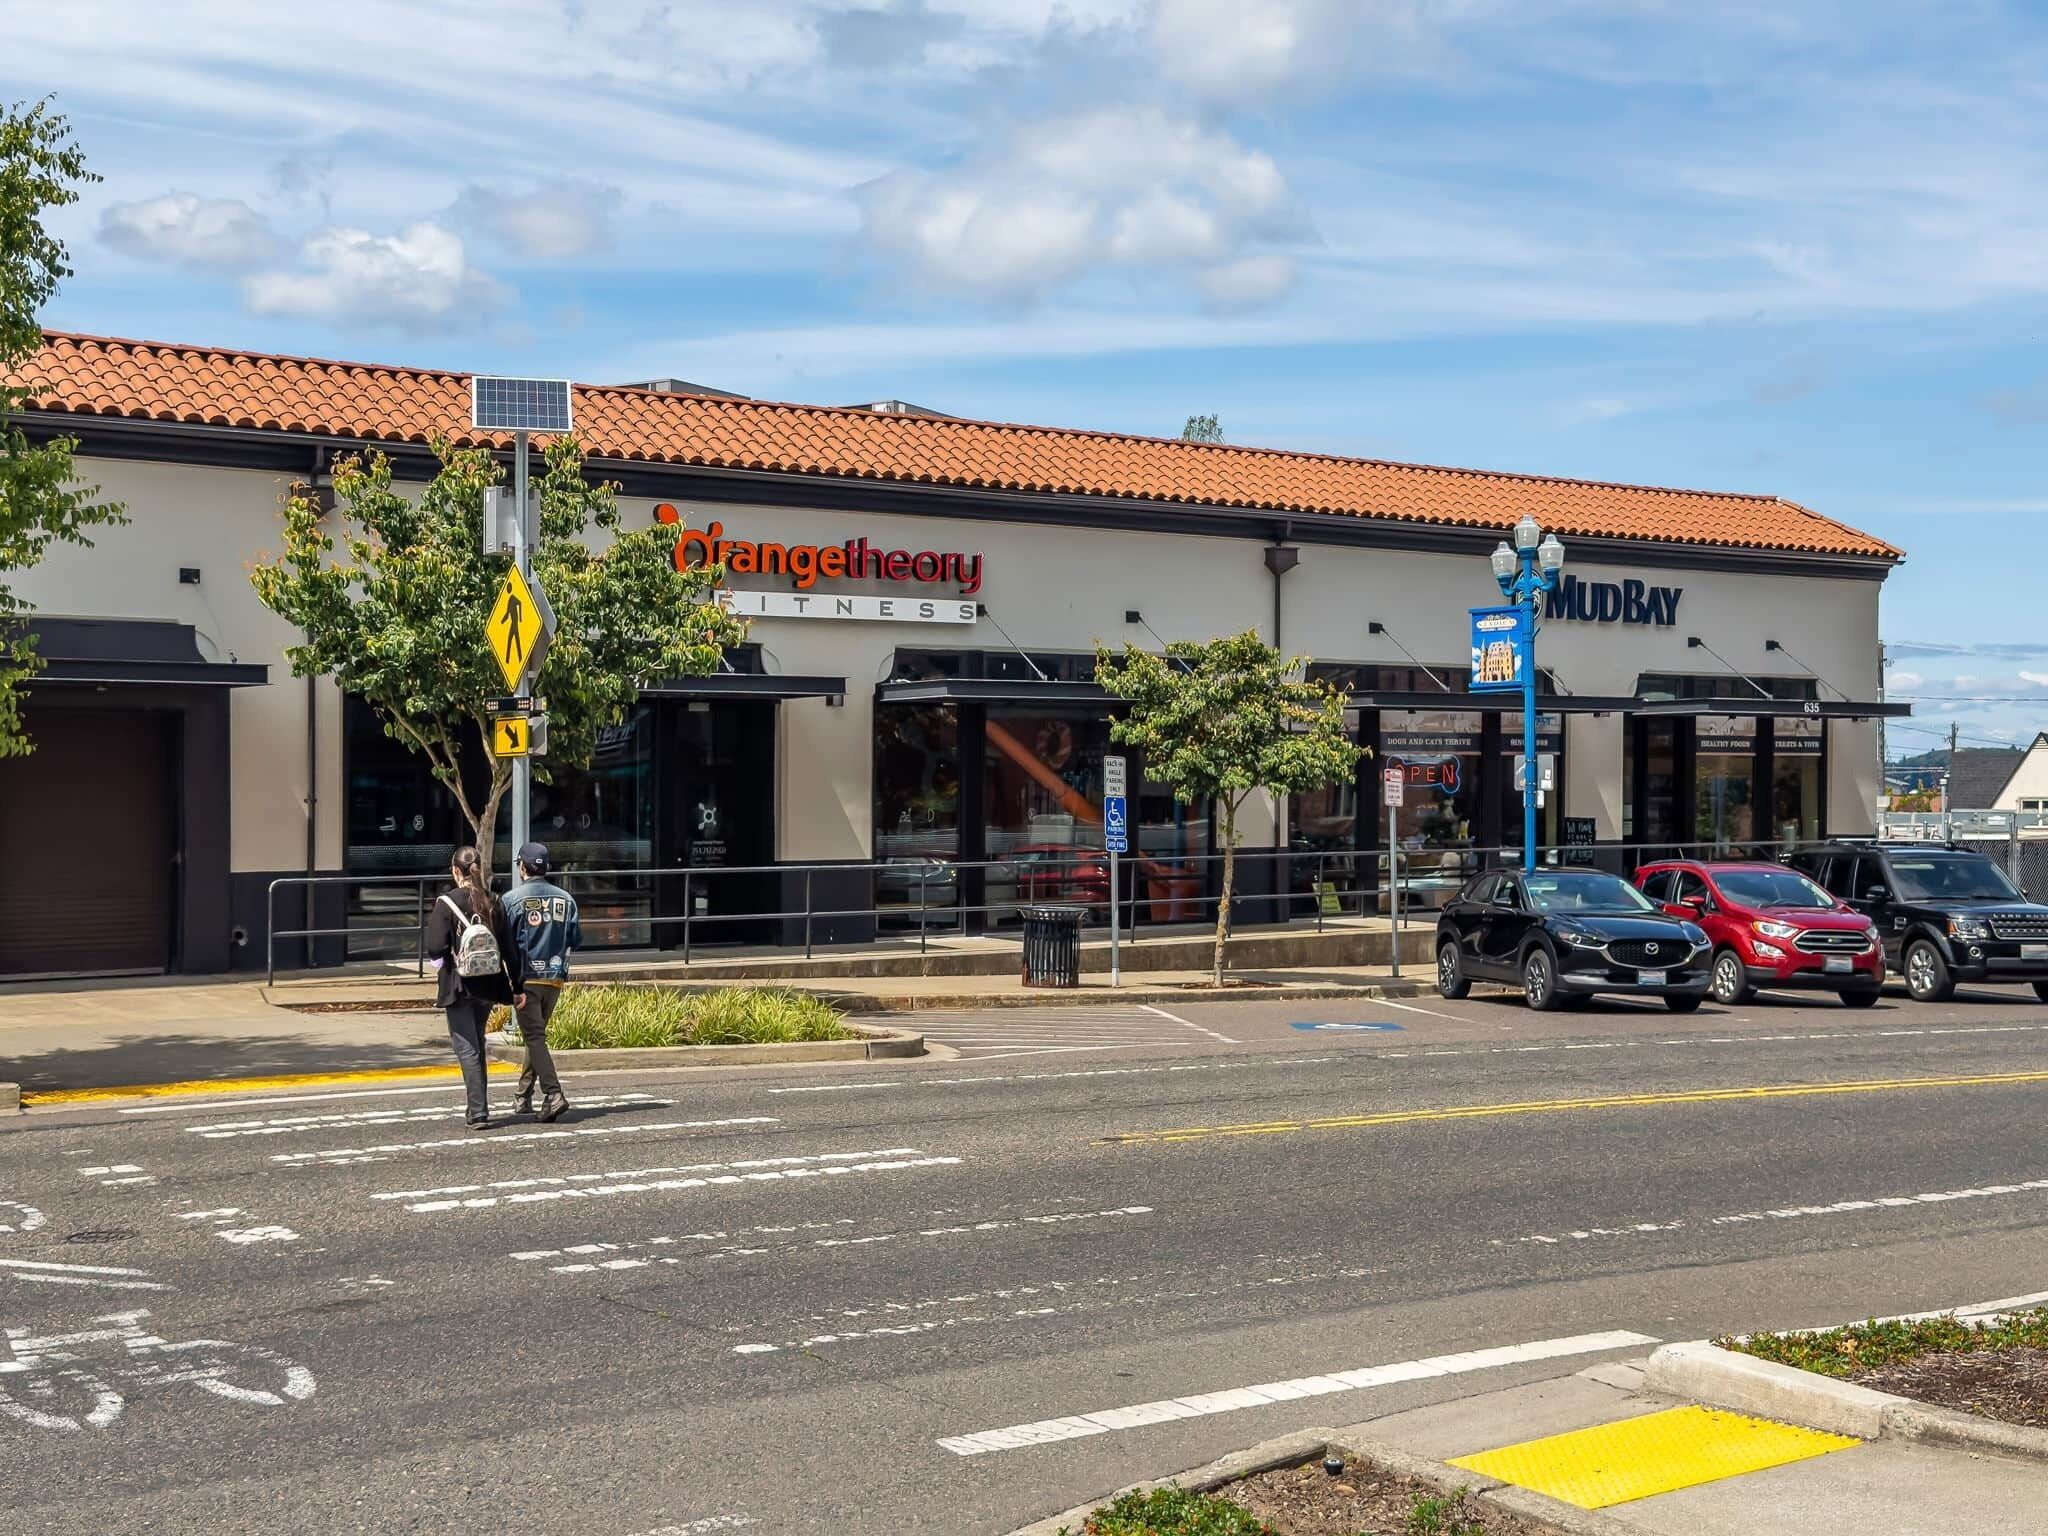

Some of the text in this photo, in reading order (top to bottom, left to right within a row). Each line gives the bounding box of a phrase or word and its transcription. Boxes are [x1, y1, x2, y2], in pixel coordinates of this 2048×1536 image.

[673, 521, 983, 594] Orangetheory
[1804, 702, 1820, 713] 635
[1444, 738, 1472, 746] THRIVE
[1700, 740, 1750, 748] HEALTHY FOODS
